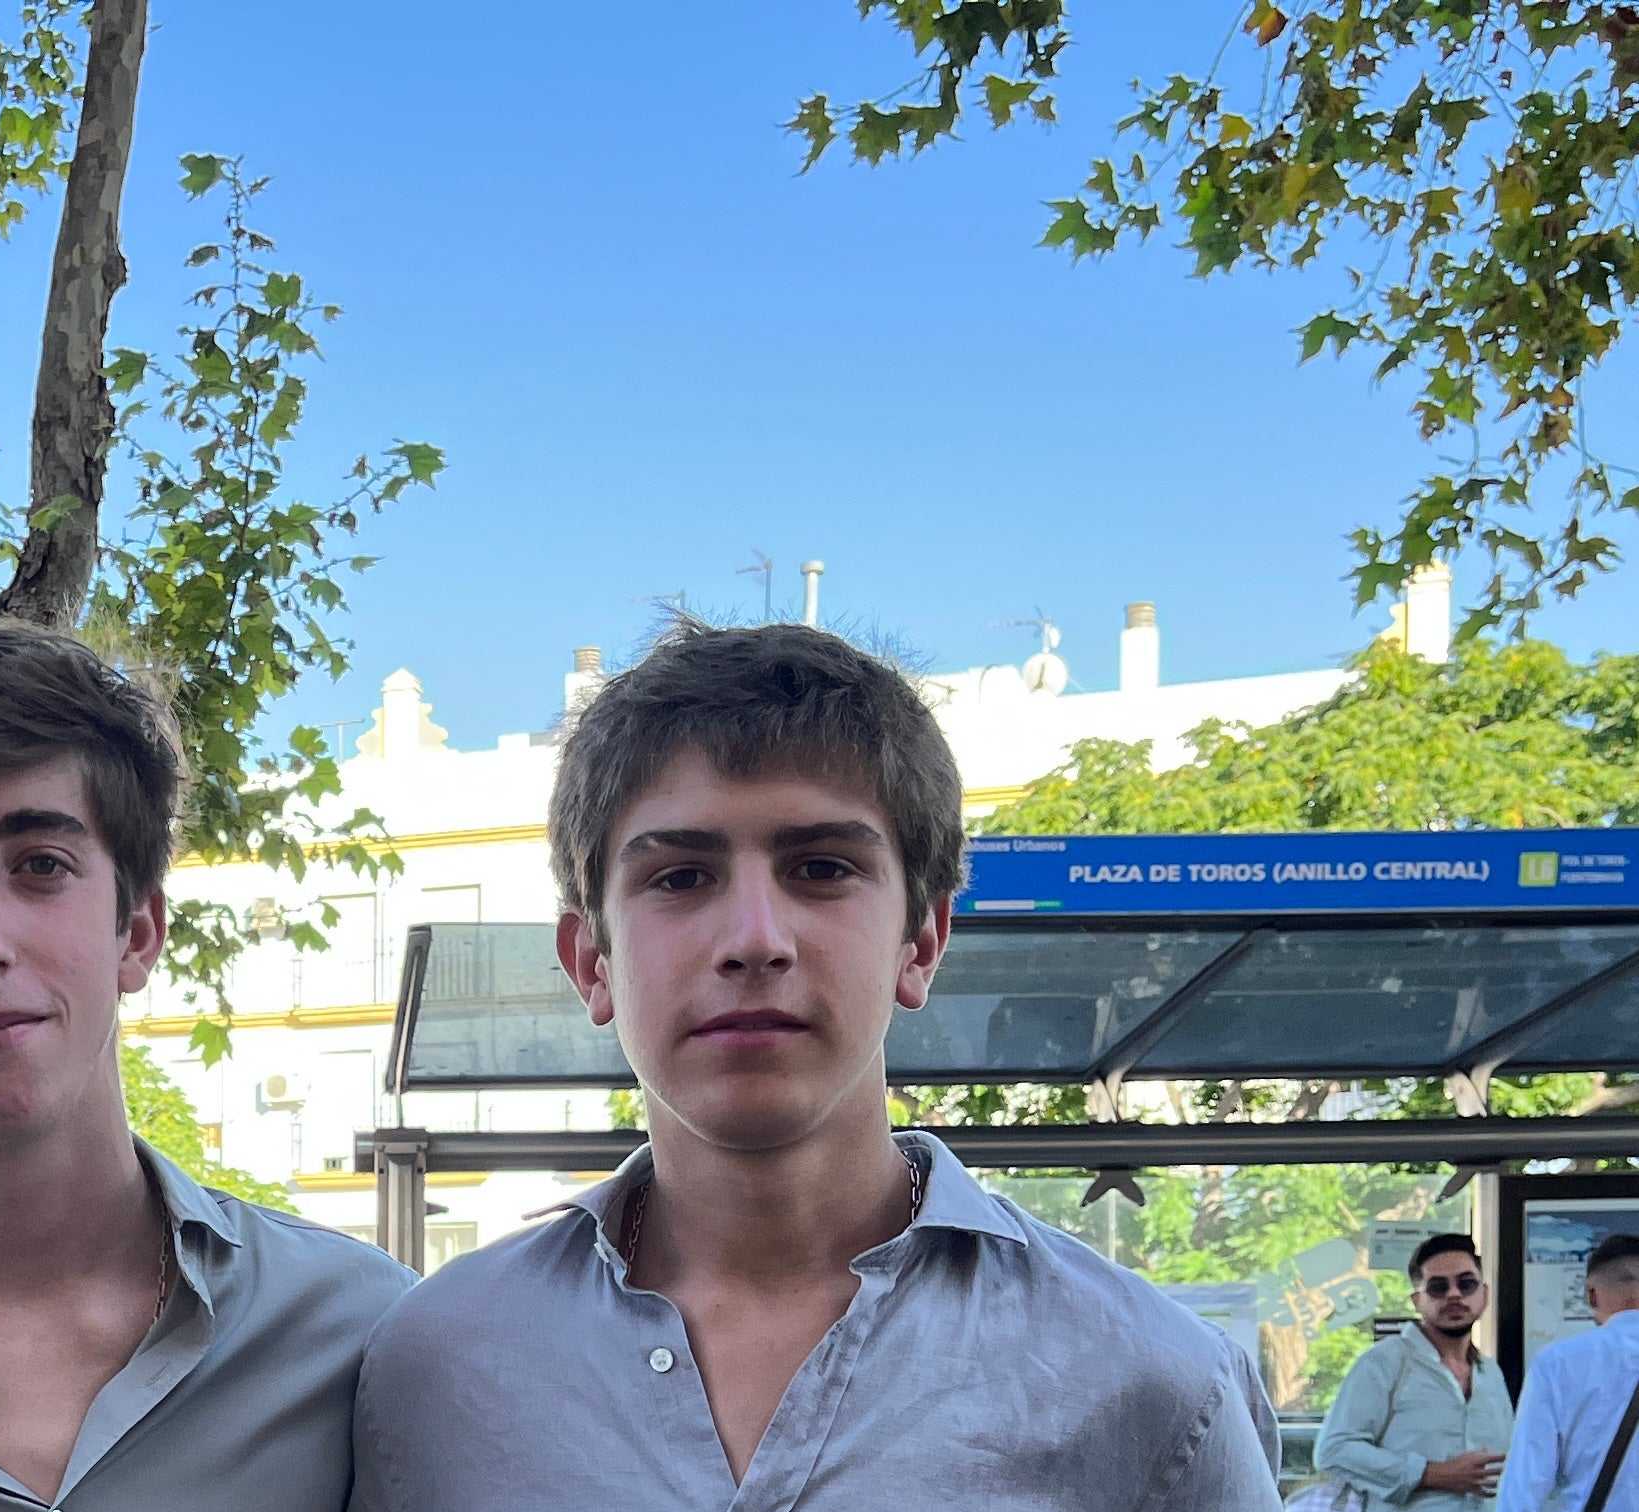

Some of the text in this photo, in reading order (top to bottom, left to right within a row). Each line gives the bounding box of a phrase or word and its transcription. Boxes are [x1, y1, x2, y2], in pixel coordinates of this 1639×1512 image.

[1069, 860, 1490, 885] PLAZA DE TOROS (ANILLO CENTRAL)
